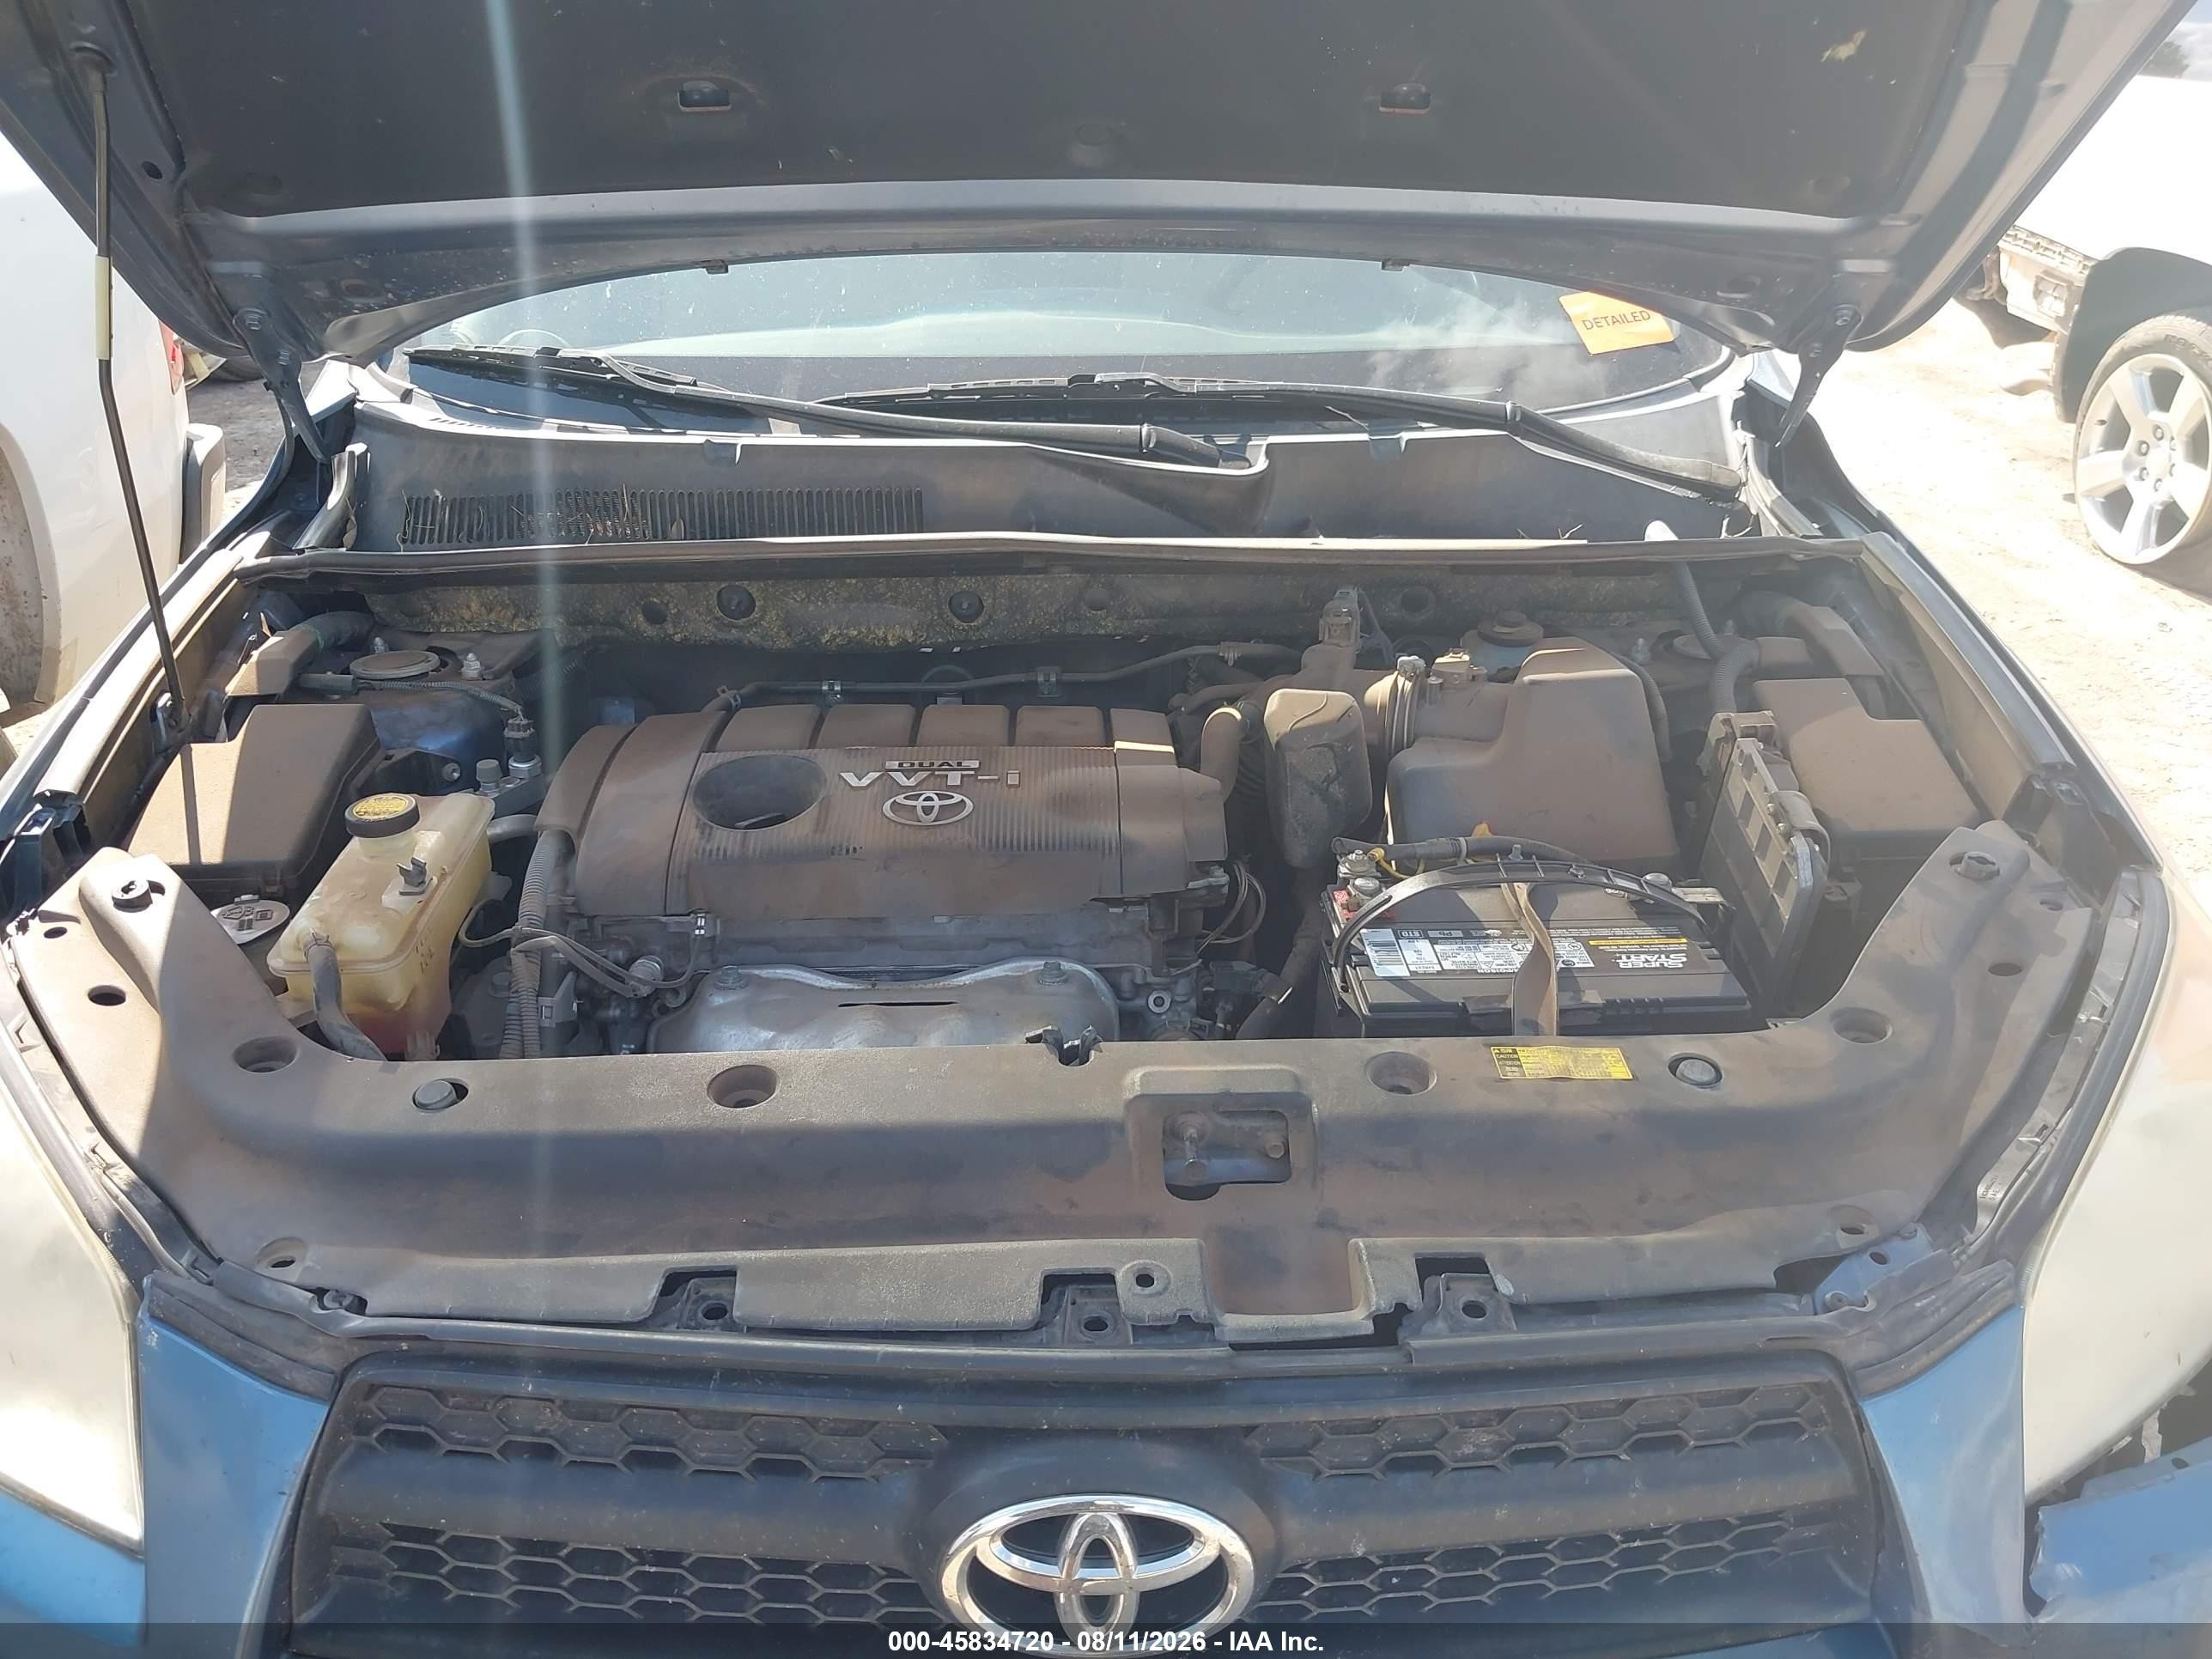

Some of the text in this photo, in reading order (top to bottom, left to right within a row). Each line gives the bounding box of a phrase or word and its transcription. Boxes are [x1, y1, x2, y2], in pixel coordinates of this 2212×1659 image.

[1582, 310, 1651, 331] DETAILED
[896, 760, 973, 769] DUAL
[838, 769, 1021, 788] VVT-i
[1616, 953, 1687, 963] START
